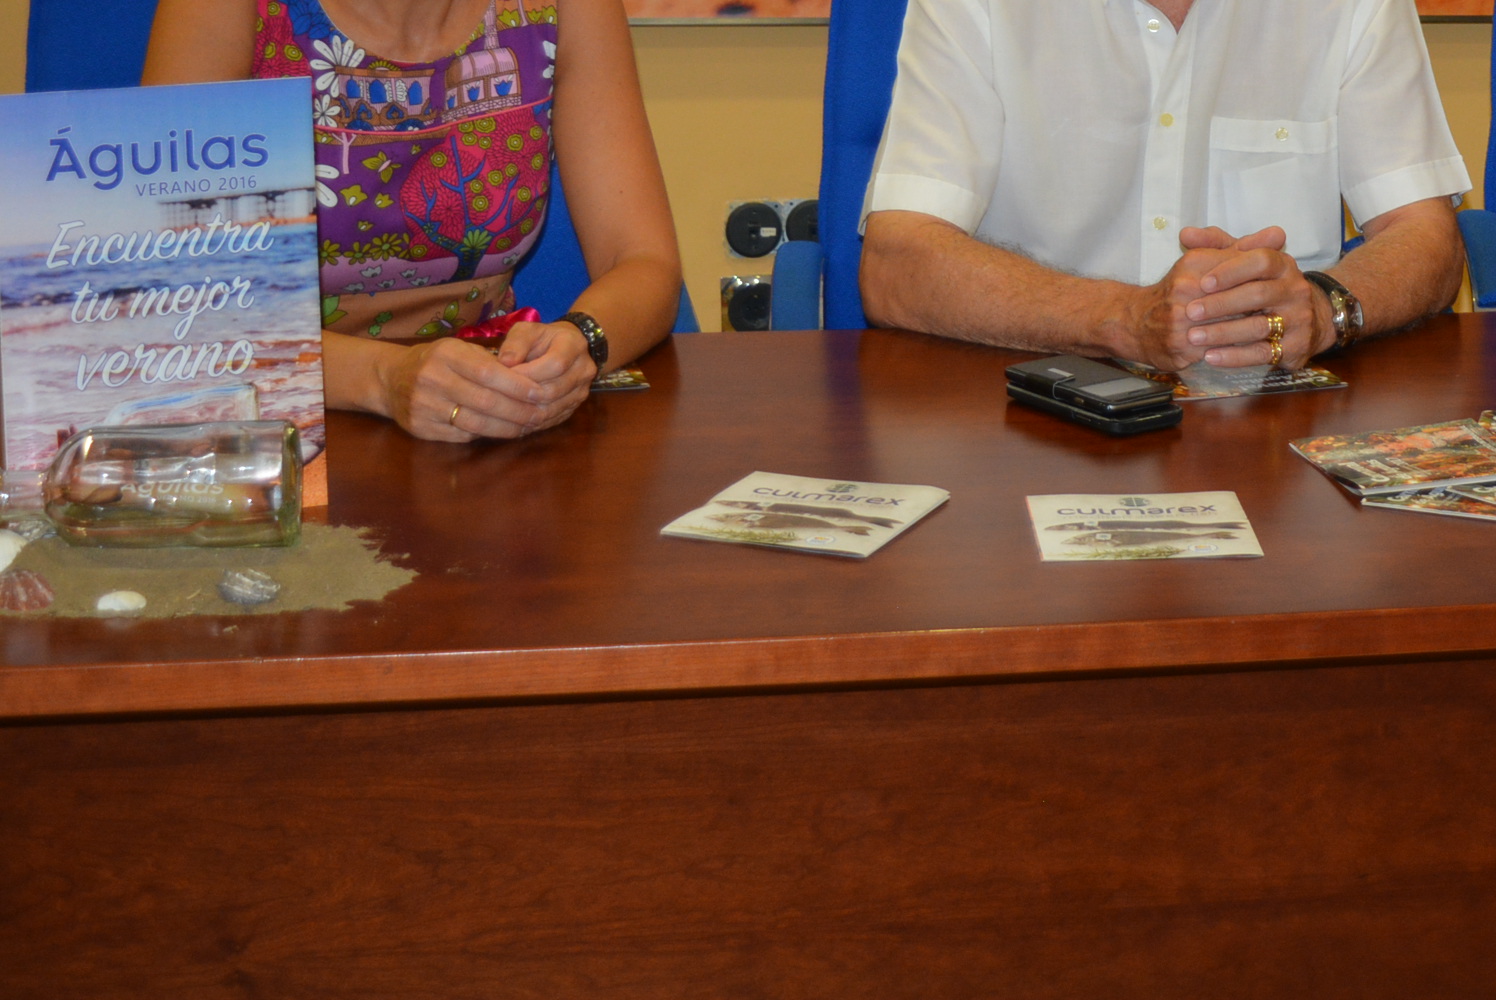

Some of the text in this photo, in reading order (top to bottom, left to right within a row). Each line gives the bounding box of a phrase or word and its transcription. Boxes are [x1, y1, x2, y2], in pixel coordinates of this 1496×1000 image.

[46, 125, 270, 191] Águilas
[136, 175, 258, 197] VERANO 2016
[46, 212, 274, 270] Encuentra
[70, 275, 255, 341] tu mejor
[74, 338, 255, 391] verano
